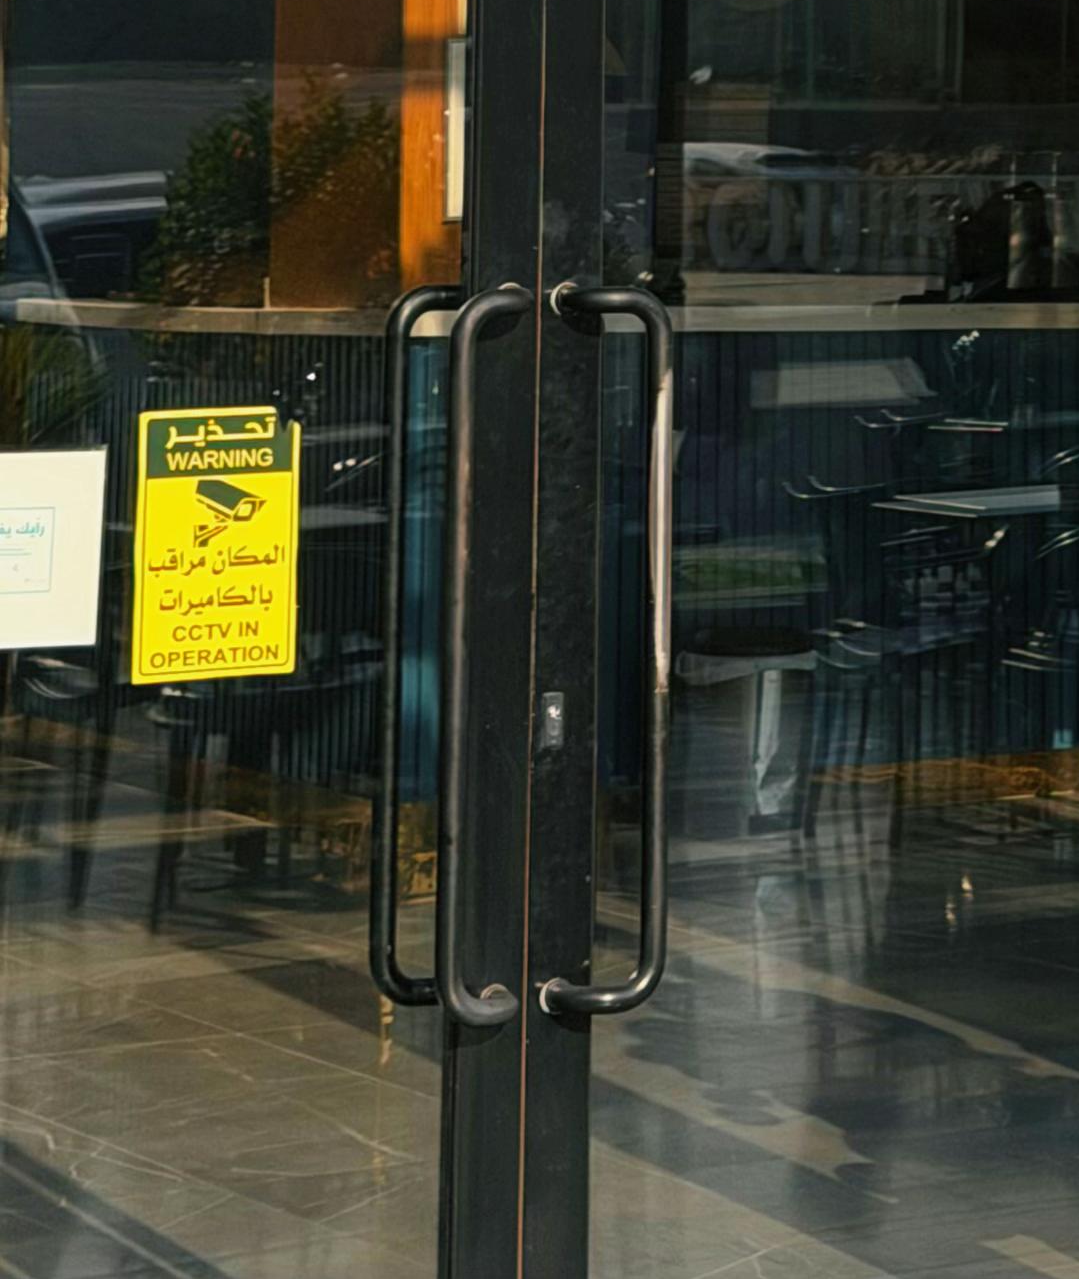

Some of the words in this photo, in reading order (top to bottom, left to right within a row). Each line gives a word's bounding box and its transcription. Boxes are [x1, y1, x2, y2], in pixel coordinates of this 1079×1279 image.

[165, 416, 277, 449] تحذير
[166, 447, 274, 471] WARNING
[148, 547, 207, 577] مراقب
[211, 544, 286, 576] المكان
[159, 584, 273, 617] بالكاميرات
[172, 621, 233, 643] CCTV
[238, 620, 260, 638] IN
[150, 644, 280, 669] OPERATION
